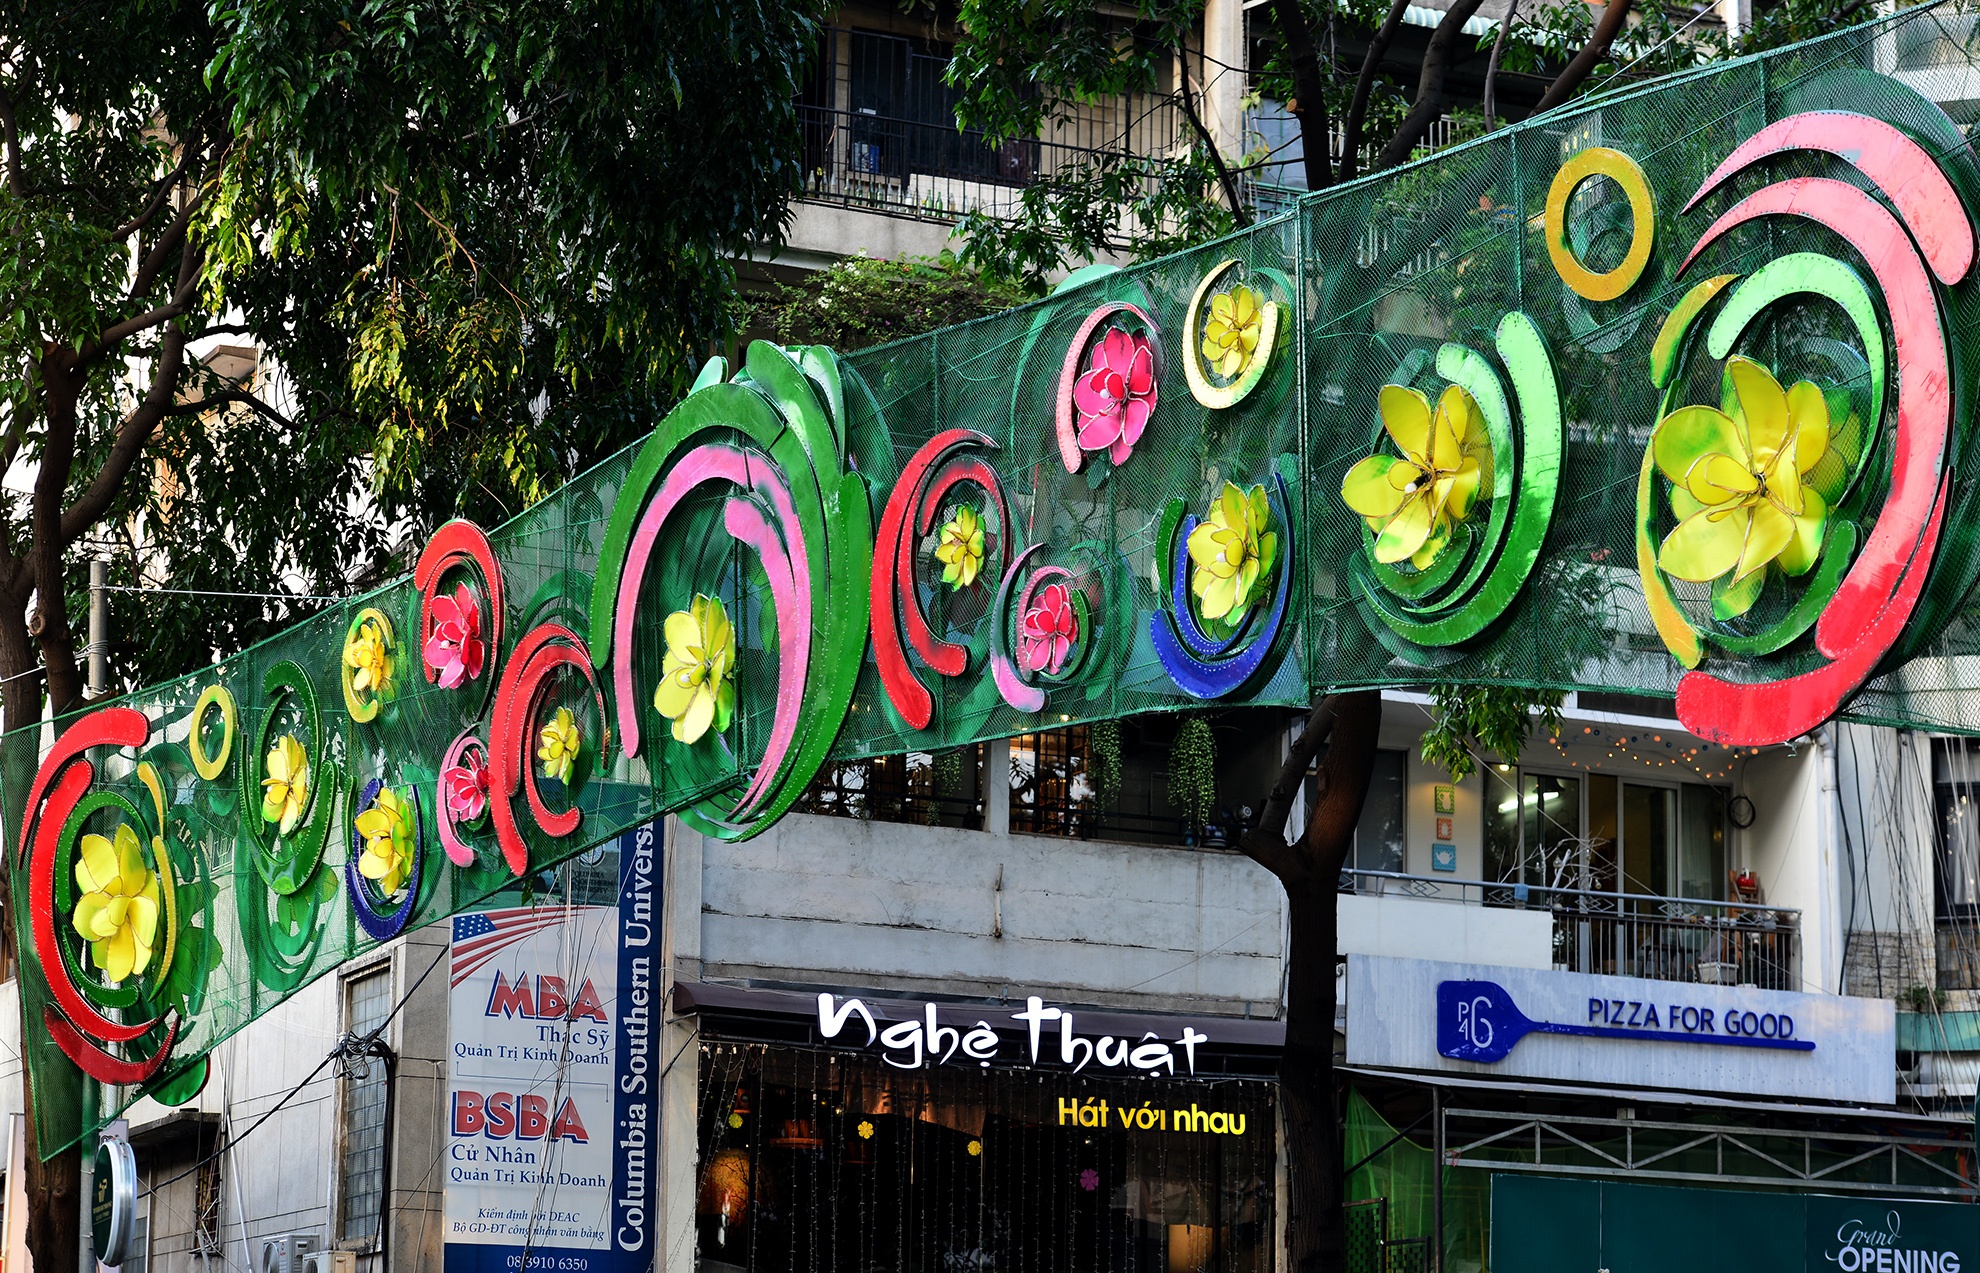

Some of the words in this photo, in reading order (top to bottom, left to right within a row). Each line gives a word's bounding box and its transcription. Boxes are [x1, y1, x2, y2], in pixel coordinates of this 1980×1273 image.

[485, 969, 609, 1025] MBA
[620, 957, 650, 1095] Southern
[1588, 997, 1660, 1028] PIZZA
[1669, 1004, 1715, 1033] FOR
[1724, 1009, 1794, 1039] GOOD
[587, 1028, 610, 1050] Sỹ
[1010, 995, 1209, 1078] Thuật
[454, 1042, 493, 1059] Quản
[497, 1045, 518, 1061] Trị
[523, 1047, 558, 1062] Kinh
[564, 1050, 609, 1064] Doanh
[451, 1090, 590, 1144] BSBA
[1058, 1097, 1109, 1127] Hát
[1117, 1101, 1166, 1130] với
[1173, 1103, 1246, 1135] nhau
[452, 1143, 479, 1161] Cử
[485, 1145, 536, 1164] Nhân
[451, 1166, 489, 1182] Quản
[494, 1169, 515, 1185] Trị
[520, 1170, 555, 1184] Kinh
[560, 1172, 607, 1187] Doanh
[617, 1103, 648, 1252] Columbia
[453, 1222, 466, 1234] Bộ
[469, 1222, 507, 1234] GD-ĐT
[508, 1224, 530, 1238] công
[560, 1227, 578, 1238] văn
[477, 1207, 504, 1219] Kiểm
[506, 1208, 528, 1221] định
[549, 1211, 580, 1223] DEAC
[1828, 1210, 1902, 1250] Grand
[558, 1257, 588, 1270] 6350
[1838, 1246, 1961, 1273] OPENING
